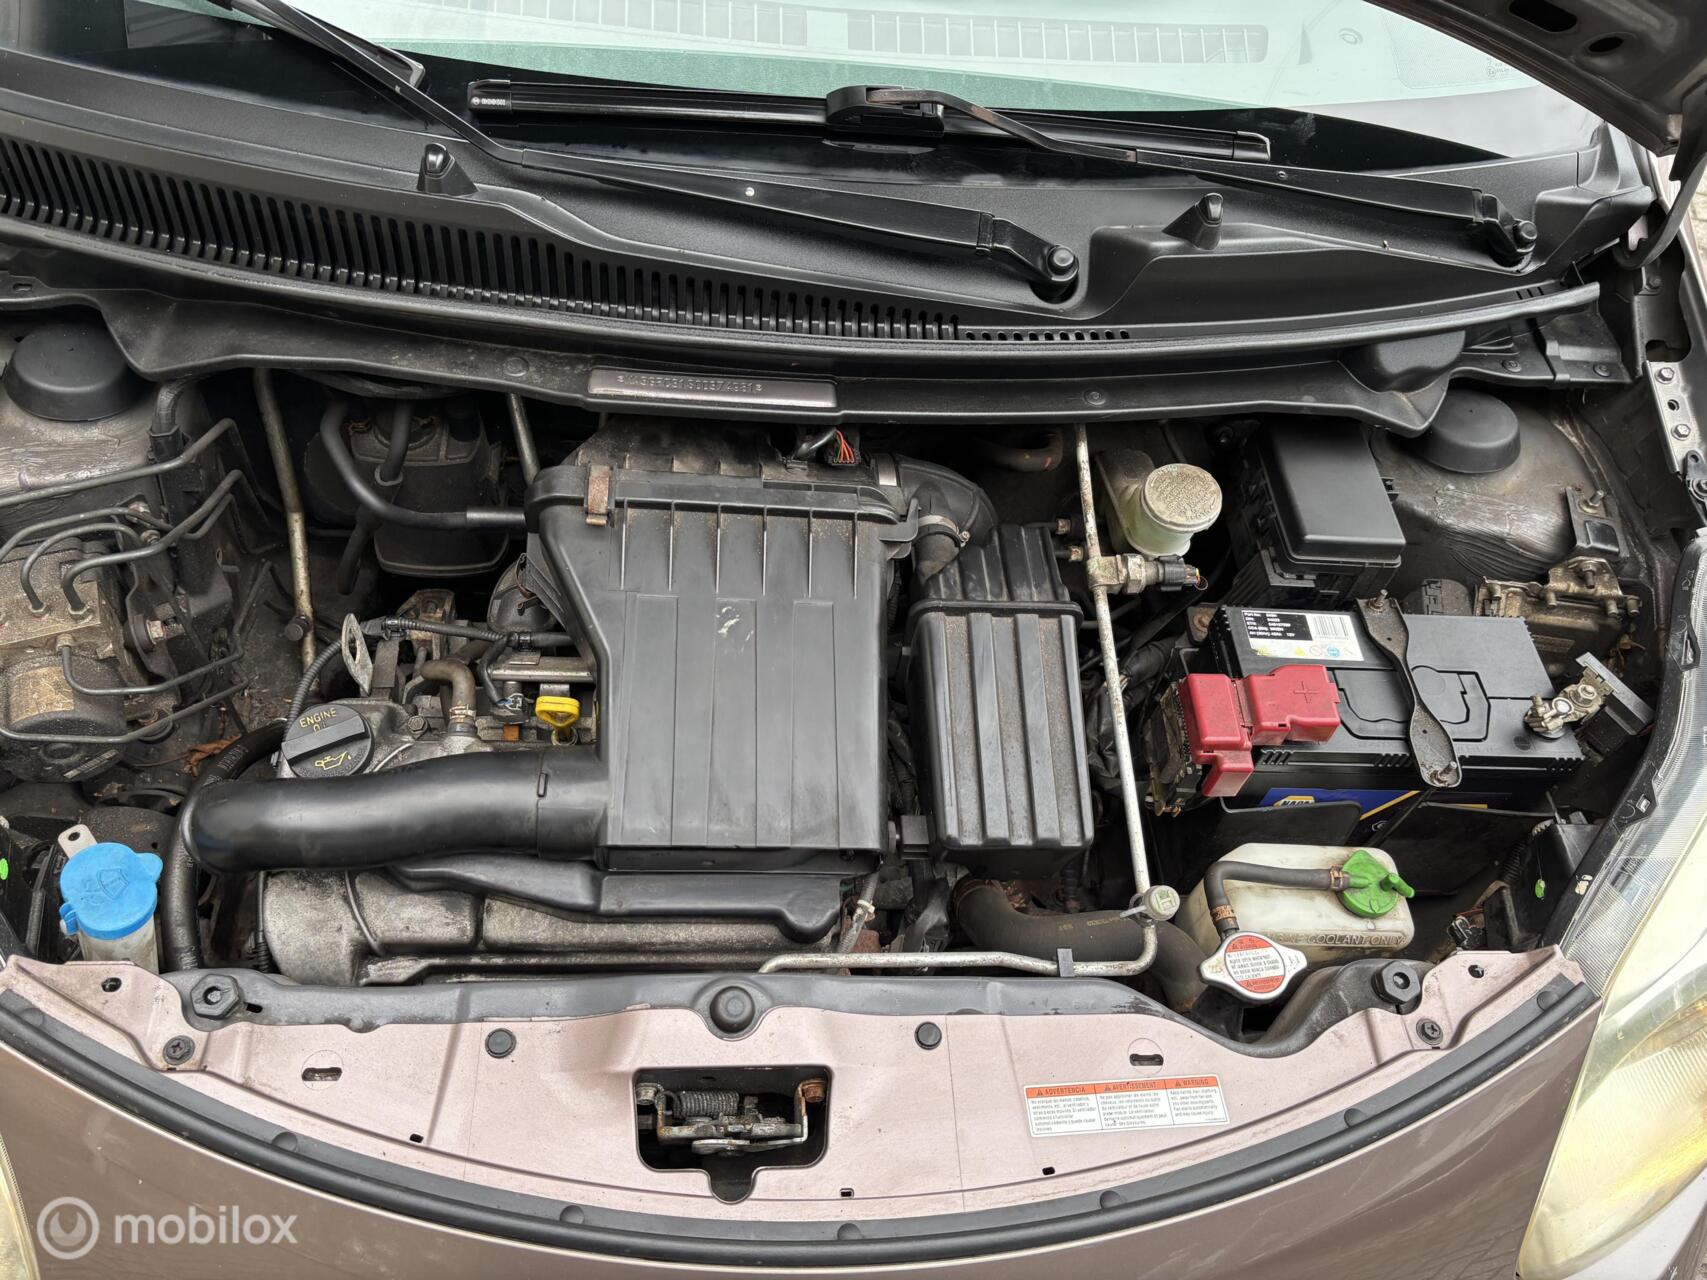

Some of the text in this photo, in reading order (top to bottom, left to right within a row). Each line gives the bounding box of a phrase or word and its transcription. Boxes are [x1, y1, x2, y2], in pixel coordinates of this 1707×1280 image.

[299, 707, 337, 728] ENGINE
[1307, 934, 1369, 945] COOLANT
[1371, 935, 1404, 945] ONLY
[1112, 1081, 1157, 1090] AVERTISSEMENT
[1045, 1087, 1086, 1095] ADVERTENCIA
